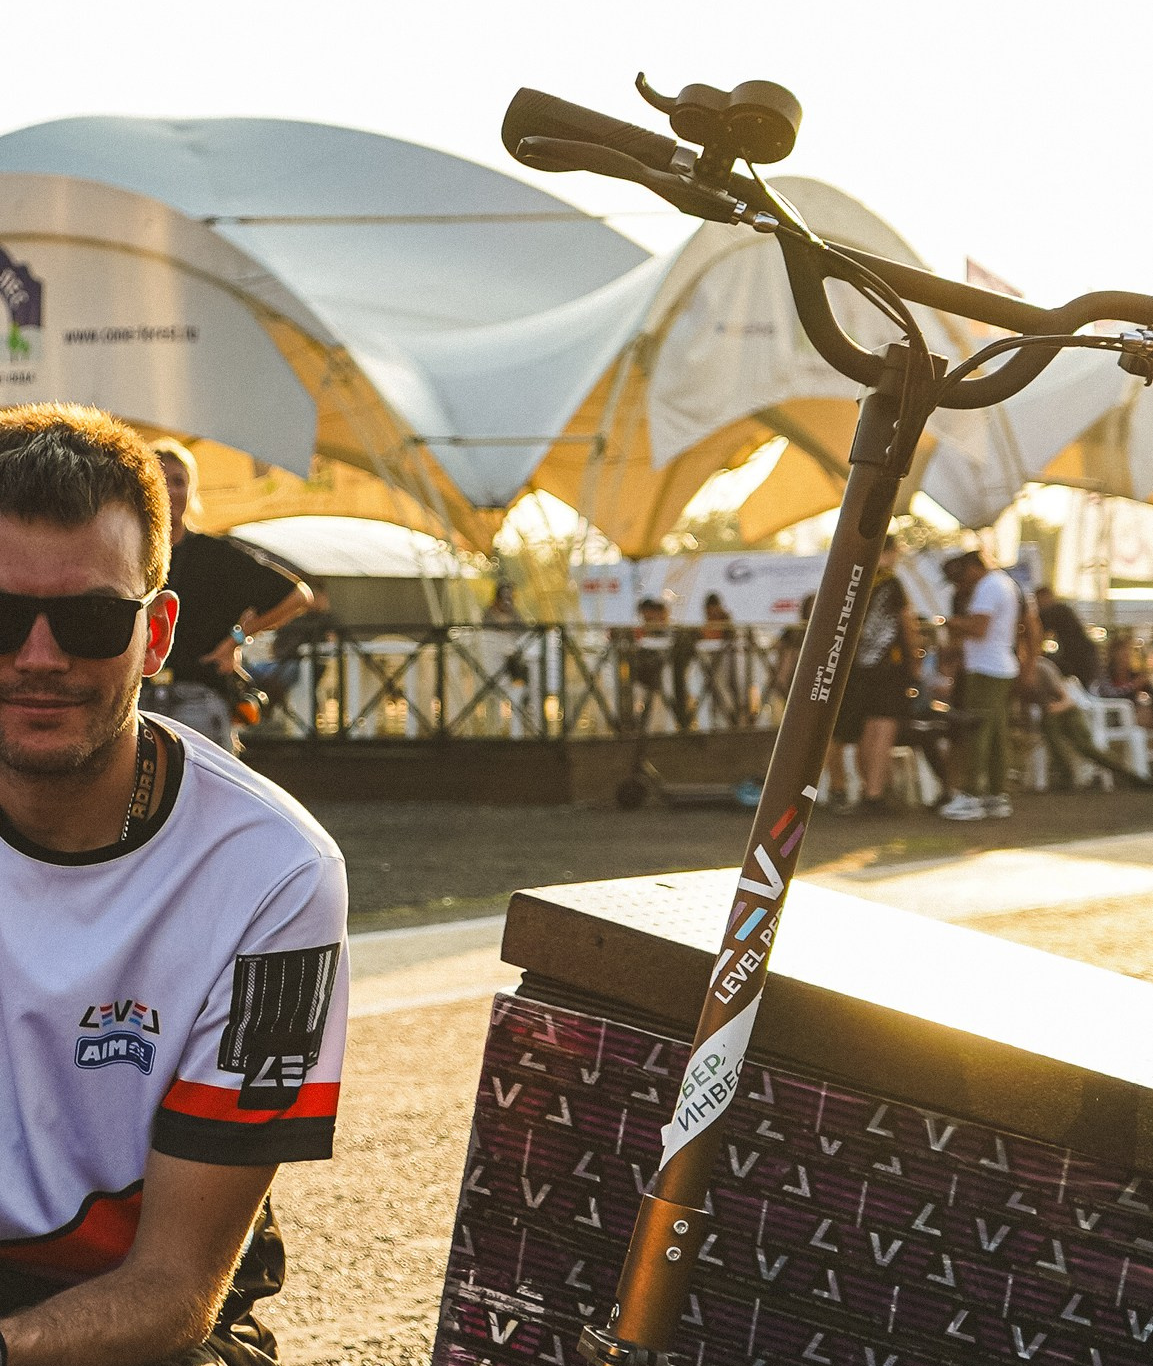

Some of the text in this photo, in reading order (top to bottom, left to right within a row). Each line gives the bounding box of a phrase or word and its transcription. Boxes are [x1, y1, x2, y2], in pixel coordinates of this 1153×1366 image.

[823, 563, 864, 685] DUALTRON
[810, 665, 825, 701] LIMITED
[714, 948, 766, 1005] LEVEL
